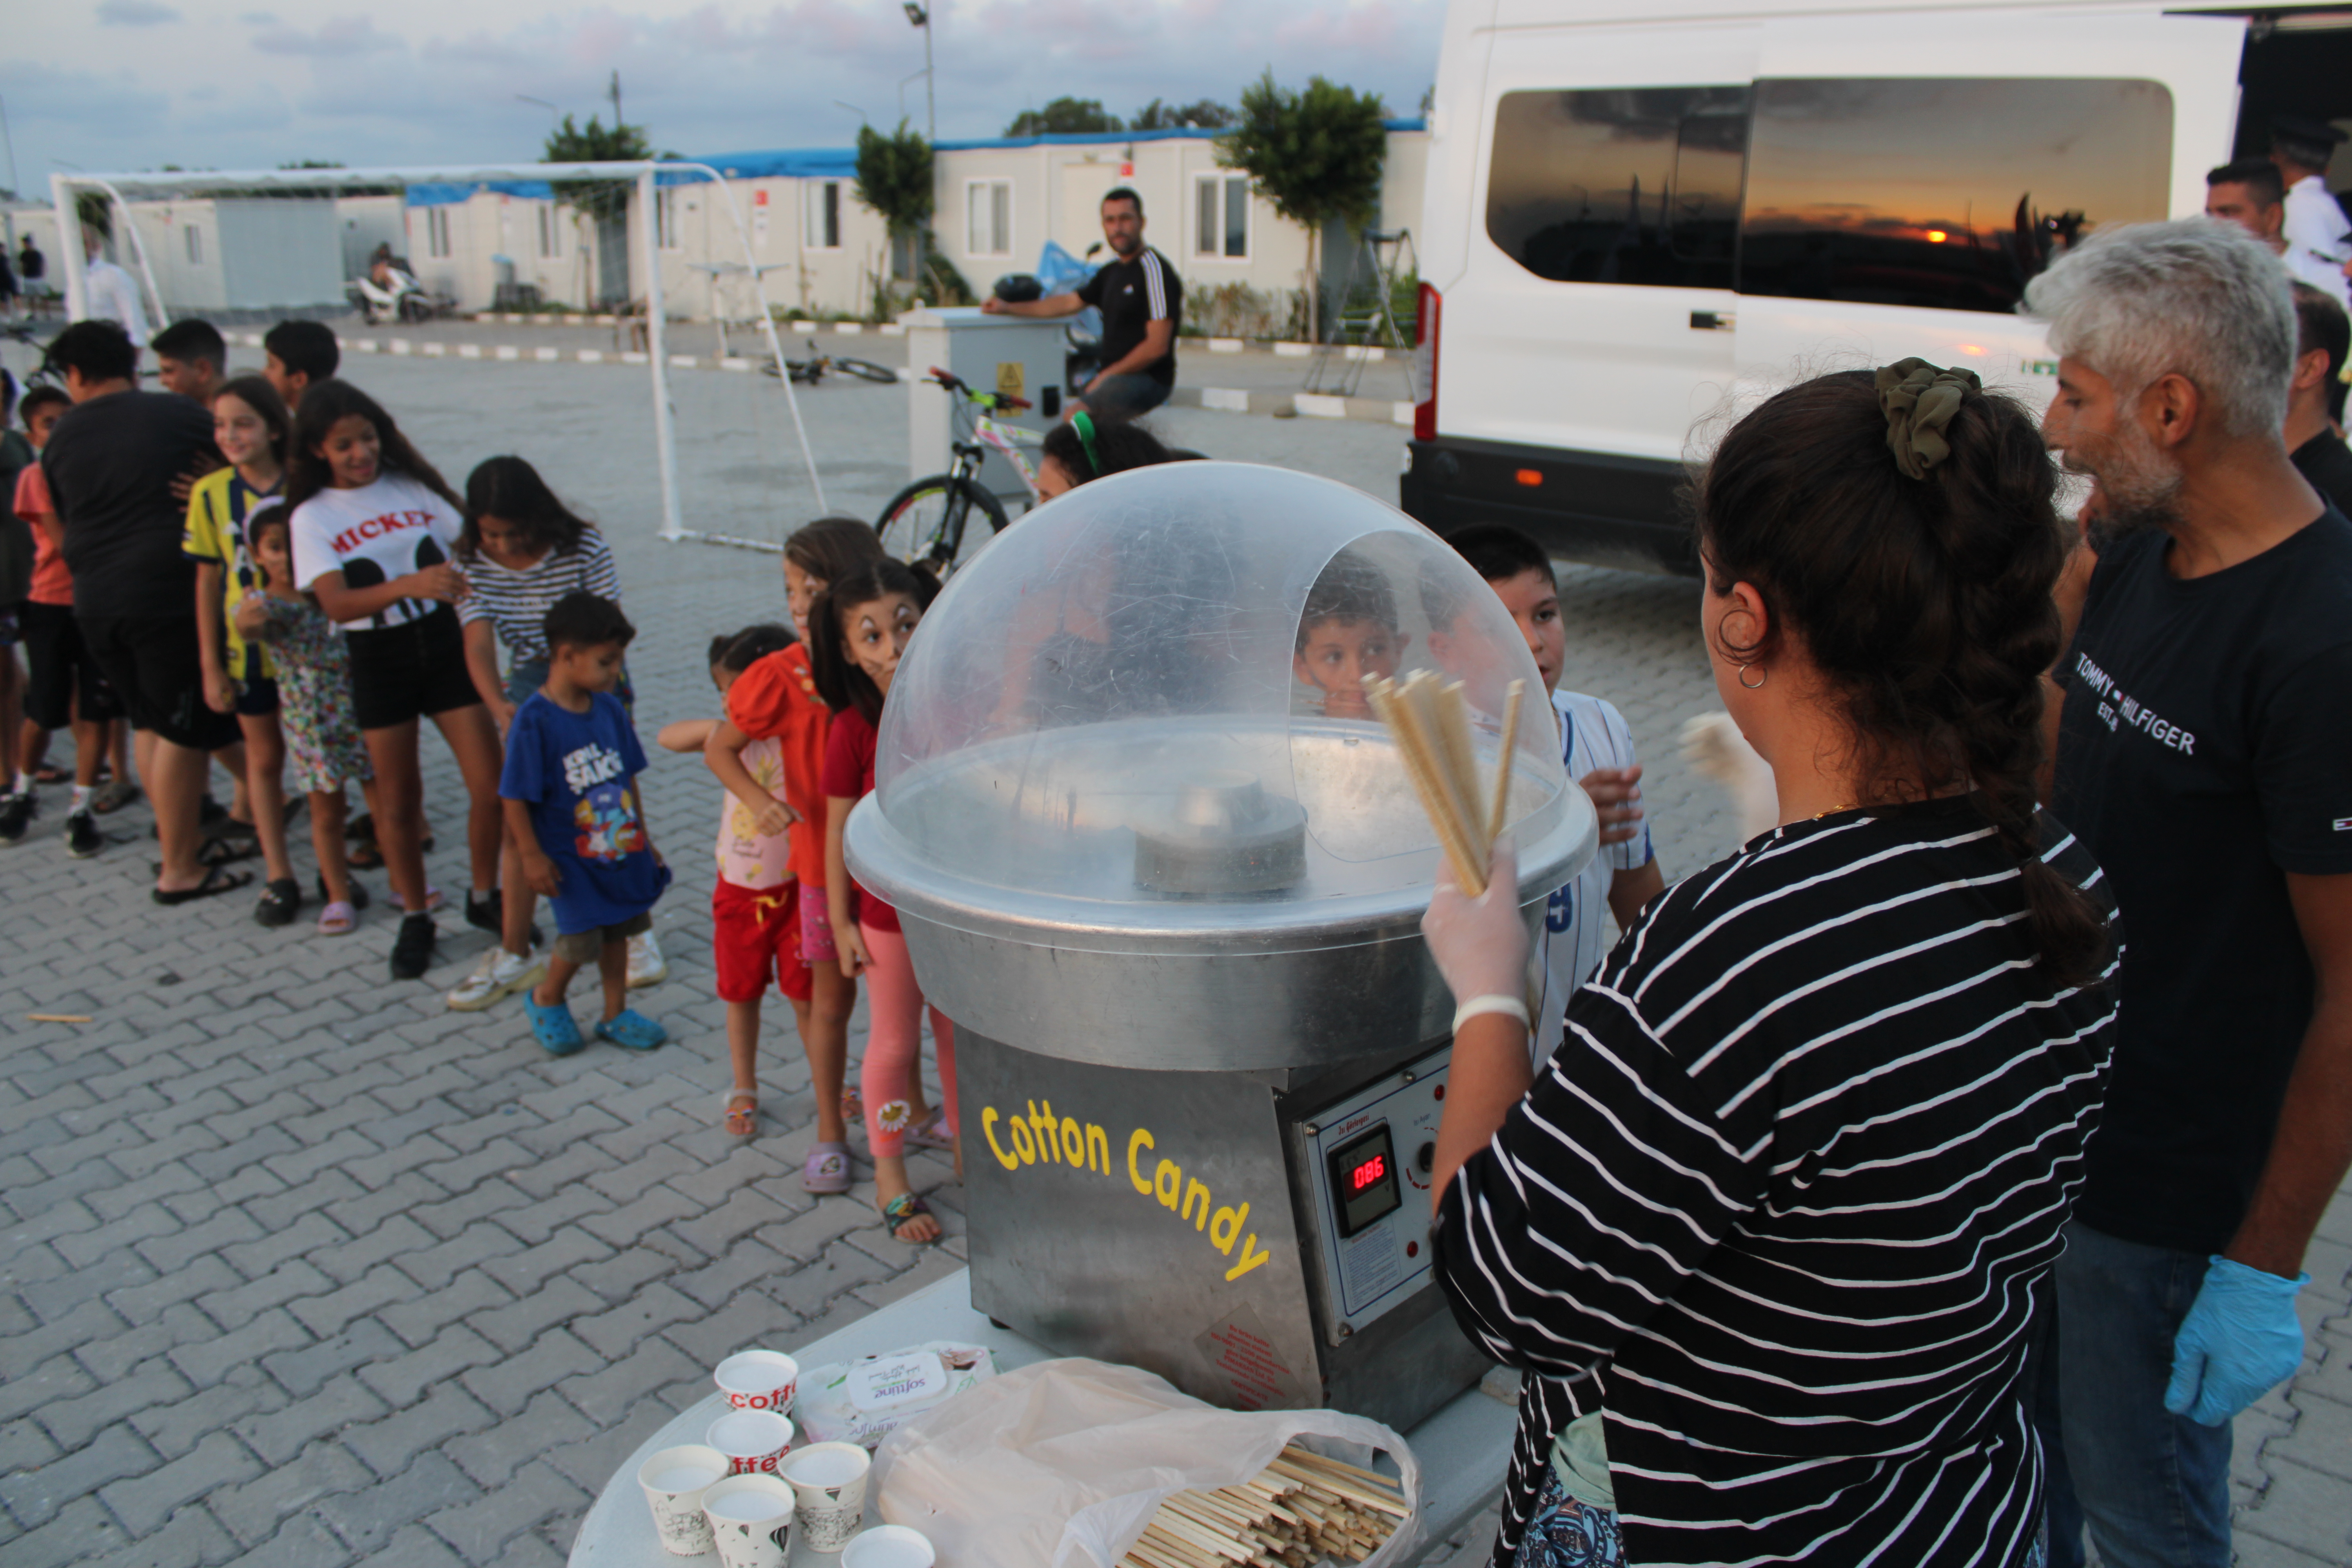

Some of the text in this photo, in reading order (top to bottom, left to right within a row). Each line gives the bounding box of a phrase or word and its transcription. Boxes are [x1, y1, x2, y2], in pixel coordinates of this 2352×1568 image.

[329, 510, 437, 554] MICKEY
[2075, 652, 2196, 755] TOMMY HILFIGER
[982, 1100, 1110, 1176] Cotton
[1127, 1128, 1270, 1282] Candy
[1354, 1155, 1384, 1189] 086
[874, 1378, 926, 1399] softline
[729, 1445, 790, 1474] ffee
